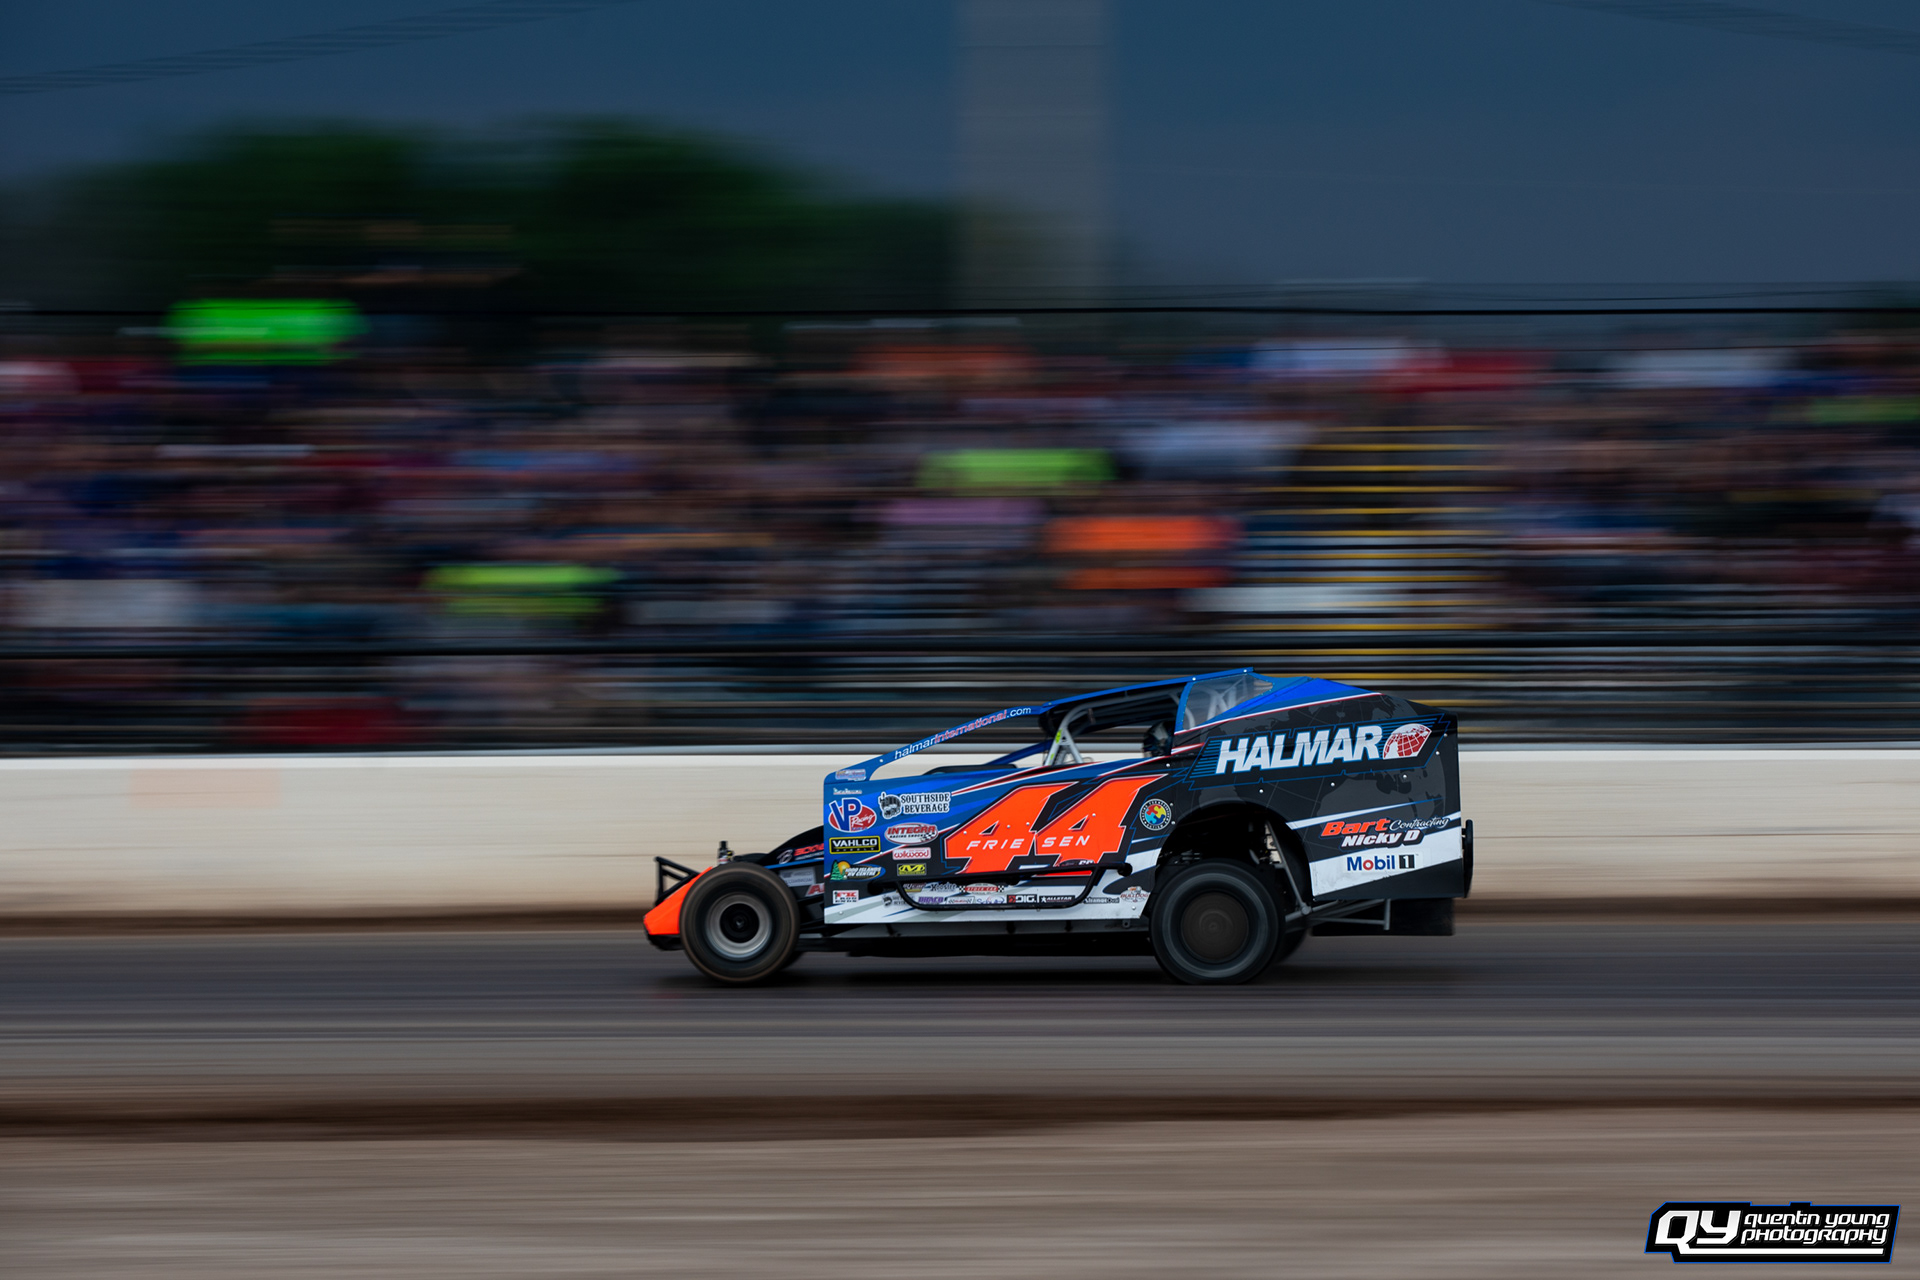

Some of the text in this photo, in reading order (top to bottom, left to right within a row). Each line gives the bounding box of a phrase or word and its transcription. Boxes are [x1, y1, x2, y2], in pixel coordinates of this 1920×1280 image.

[894, 707, 1032, 760] halmarinternational.com
[1215, 725, 1383, 774] HALMAR
[900, 793, 951, 804] SOUTHSIDE
[904, 802, 949, 813] BEVERAGE
[829, 797, 862, 832] VP
[887, 825, 936, 835] INTEGRA
[944, 774, 1169, 875] 44
[1320, 816, 1450, 837] Bart Contracting
[832, 838, 877, 847] VAHLCO
[1341, 829, 1420, 848] Nicky D
[1346, 855, 1396, 871] Mobil
